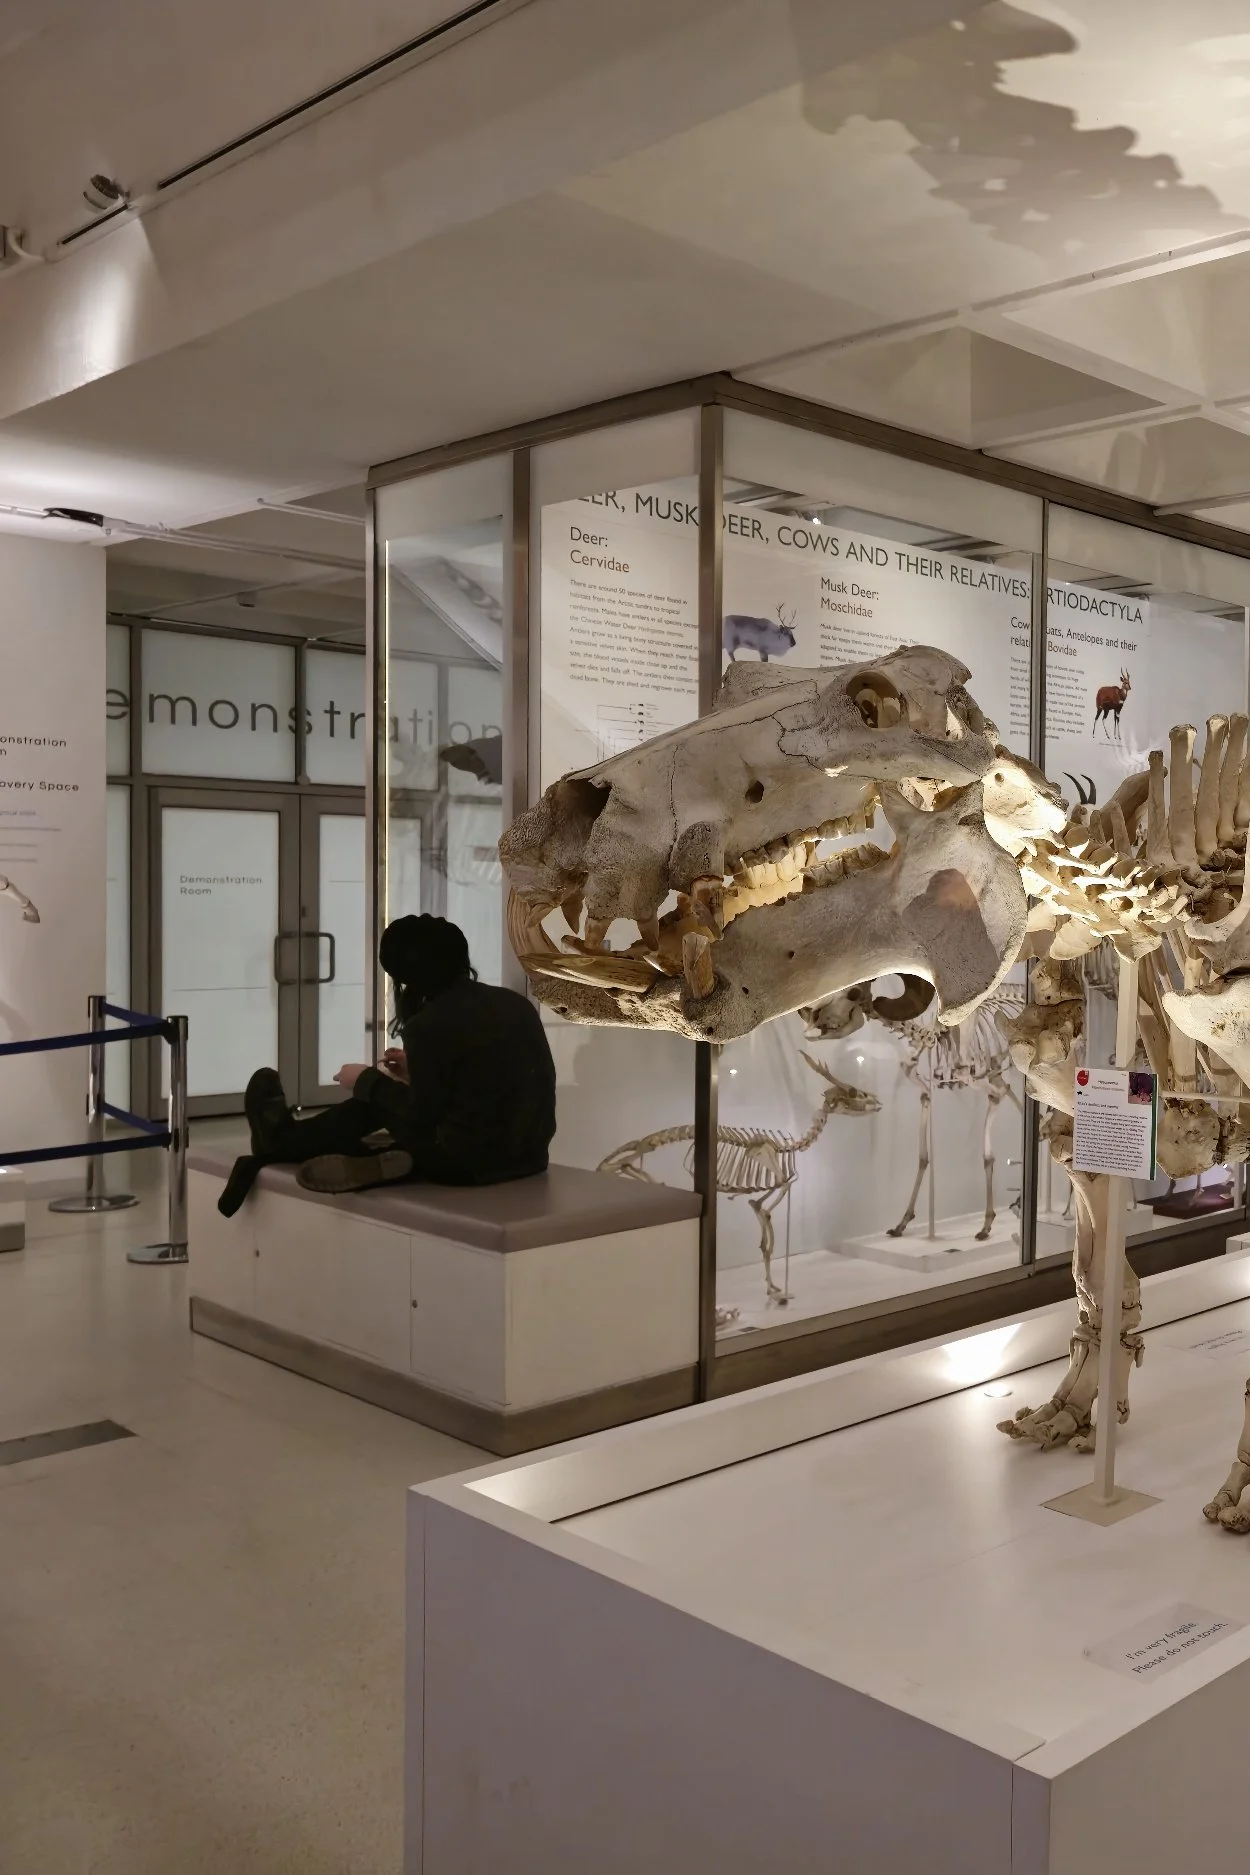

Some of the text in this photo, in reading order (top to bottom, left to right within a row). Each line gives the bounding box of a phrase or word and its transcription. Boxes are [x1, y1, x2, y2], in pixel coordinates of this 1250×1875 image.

[570, 526, 608, 547] Deer:
[570, 549, 630, 573] Cervidae
[635, 492, 700, 527] MUSK
[723, 513, 769, 544] EER,
[777, 526, 840, 556] COWS
[846, 541, 889, 567] AND
[895, 551, 944, 580] THEIR
[950, 564, 1031, 599] RELATIVES:
[1046, 587, 1143, 624] RTIODACTYLA
[820, 576, 880, 601] Musk Deer:
[820, 596, 873, 618] Moschidae
[1010, 616, 1138, 652] Cow oats, Antelopes and their
[1010, 636, 1077, 657] relati Bovidae
[106, 689, 502, 745] emonstration
[39, 781, 79, 792] Space
[180, 875, 262, 884] Demonstration
[180, 887, 212, 895] Room
[1146, 1637, 1169, 1650] very
[1131, 1655, 1167, 1674] Please
[1166, 1648, 1181, 1656] do
[1180, 1637, 1199, 1649] not
